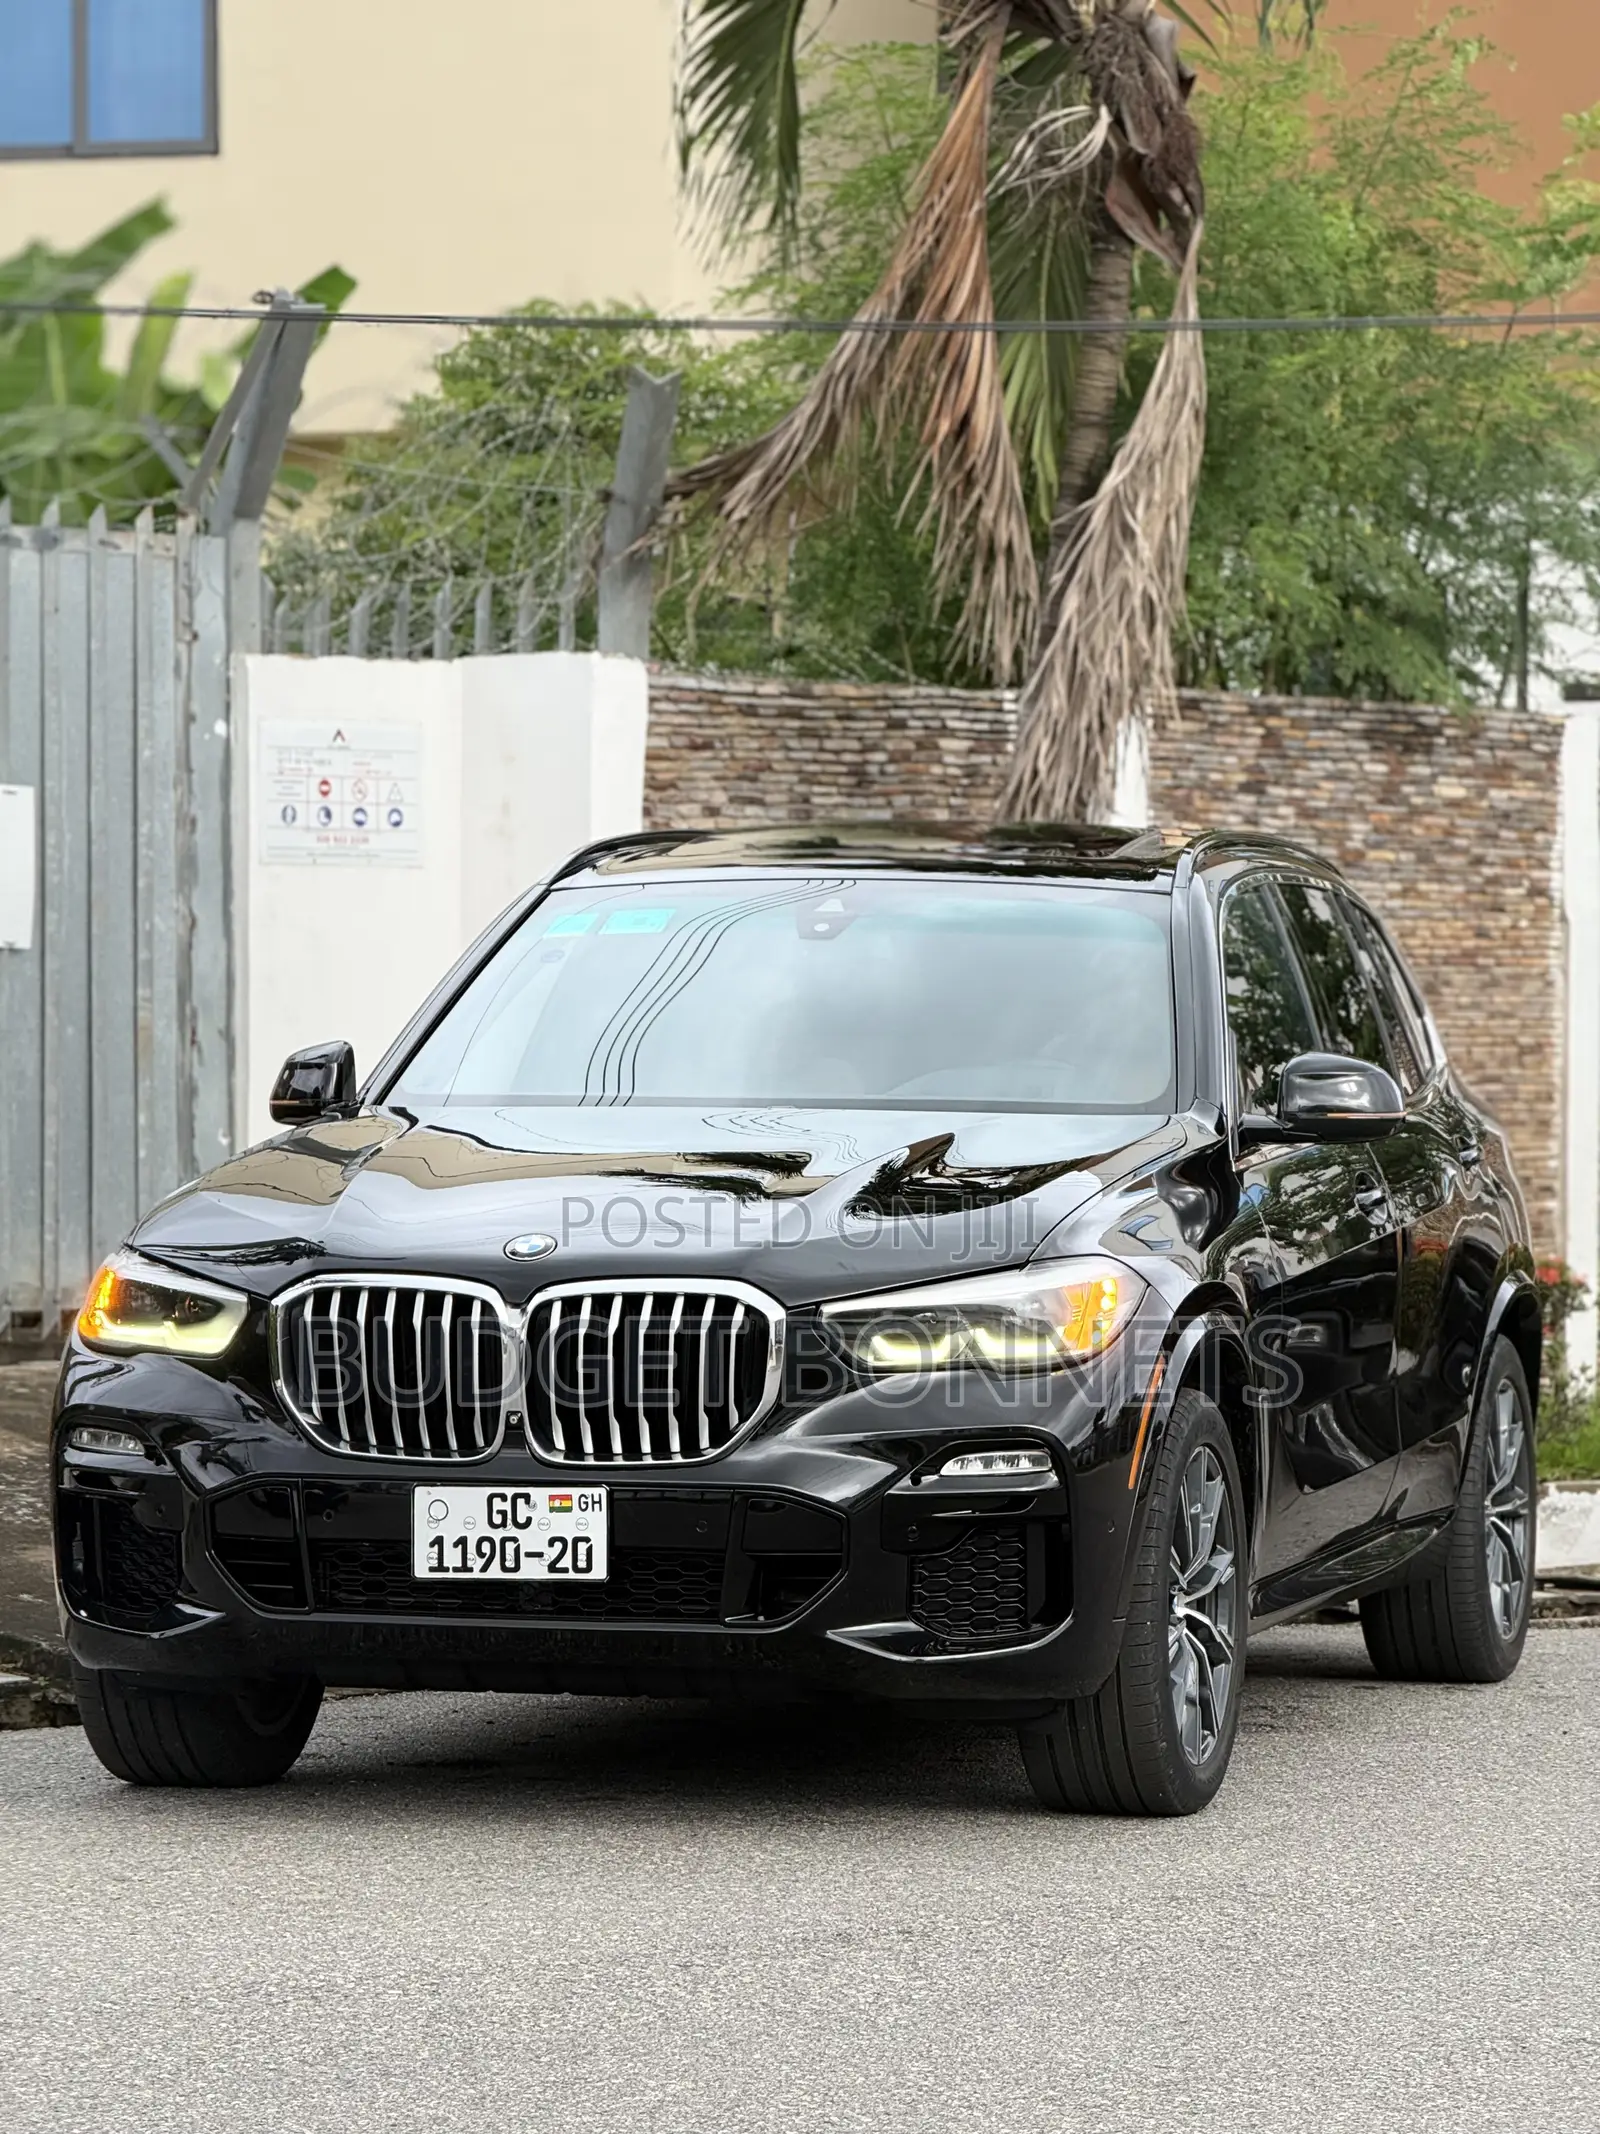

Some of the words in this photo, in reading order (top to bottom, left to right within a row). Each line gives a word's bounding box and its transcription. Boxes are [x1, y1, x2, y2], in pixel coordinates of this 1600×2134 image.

[487, 1492, 532, 1530] GC
[578, 1493, 602, 1512] GH
[428, 1535, 593, 1574] 1190-20
